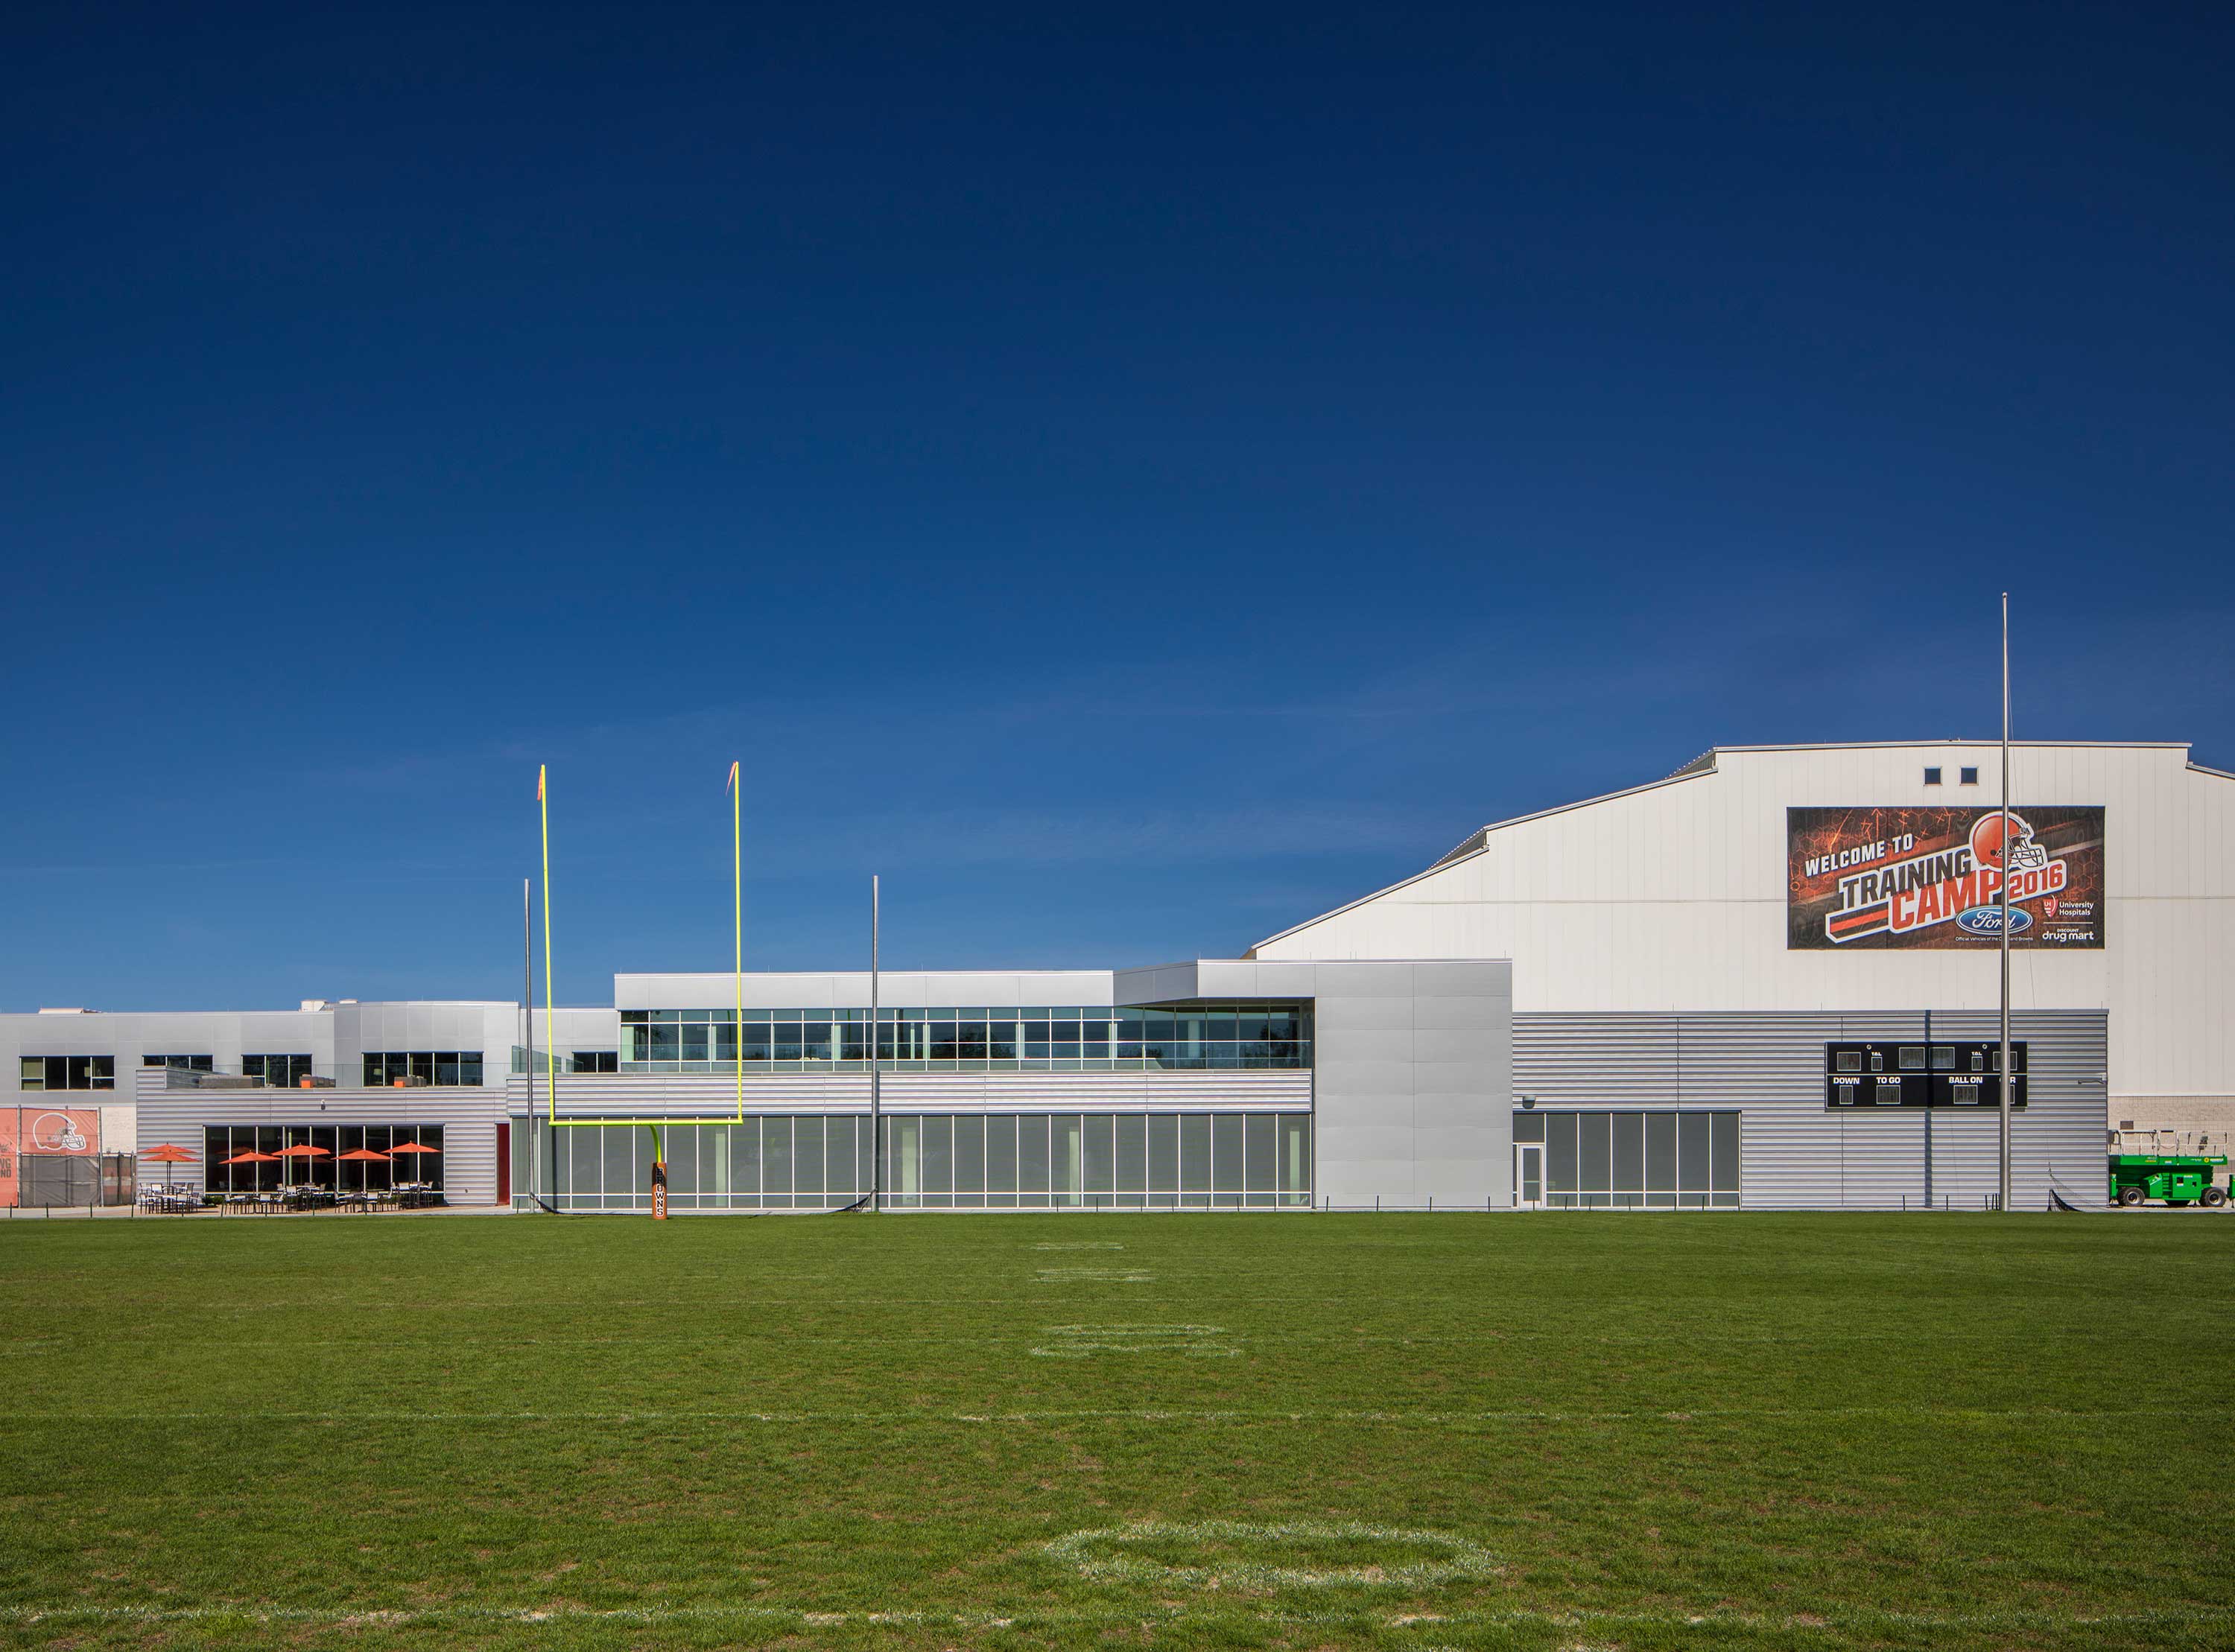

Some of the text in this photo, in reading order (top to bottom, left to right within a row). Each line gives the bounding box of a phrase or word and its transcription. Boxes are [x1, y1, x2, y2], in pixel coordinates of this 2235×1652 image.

[1805, 833, 1913, 877] WELCOME TO
[1842, 848, 1972, 909] TRAINING
[1892, 863, 2063, 930] CAMP 2016
[2059, 900, 2094, 910] University
[2059, 909, 2090, 917] Hospitals
[2042, 931, 2094, 942] drug mart
[655, 1167, 665, 1216] BROWNS
